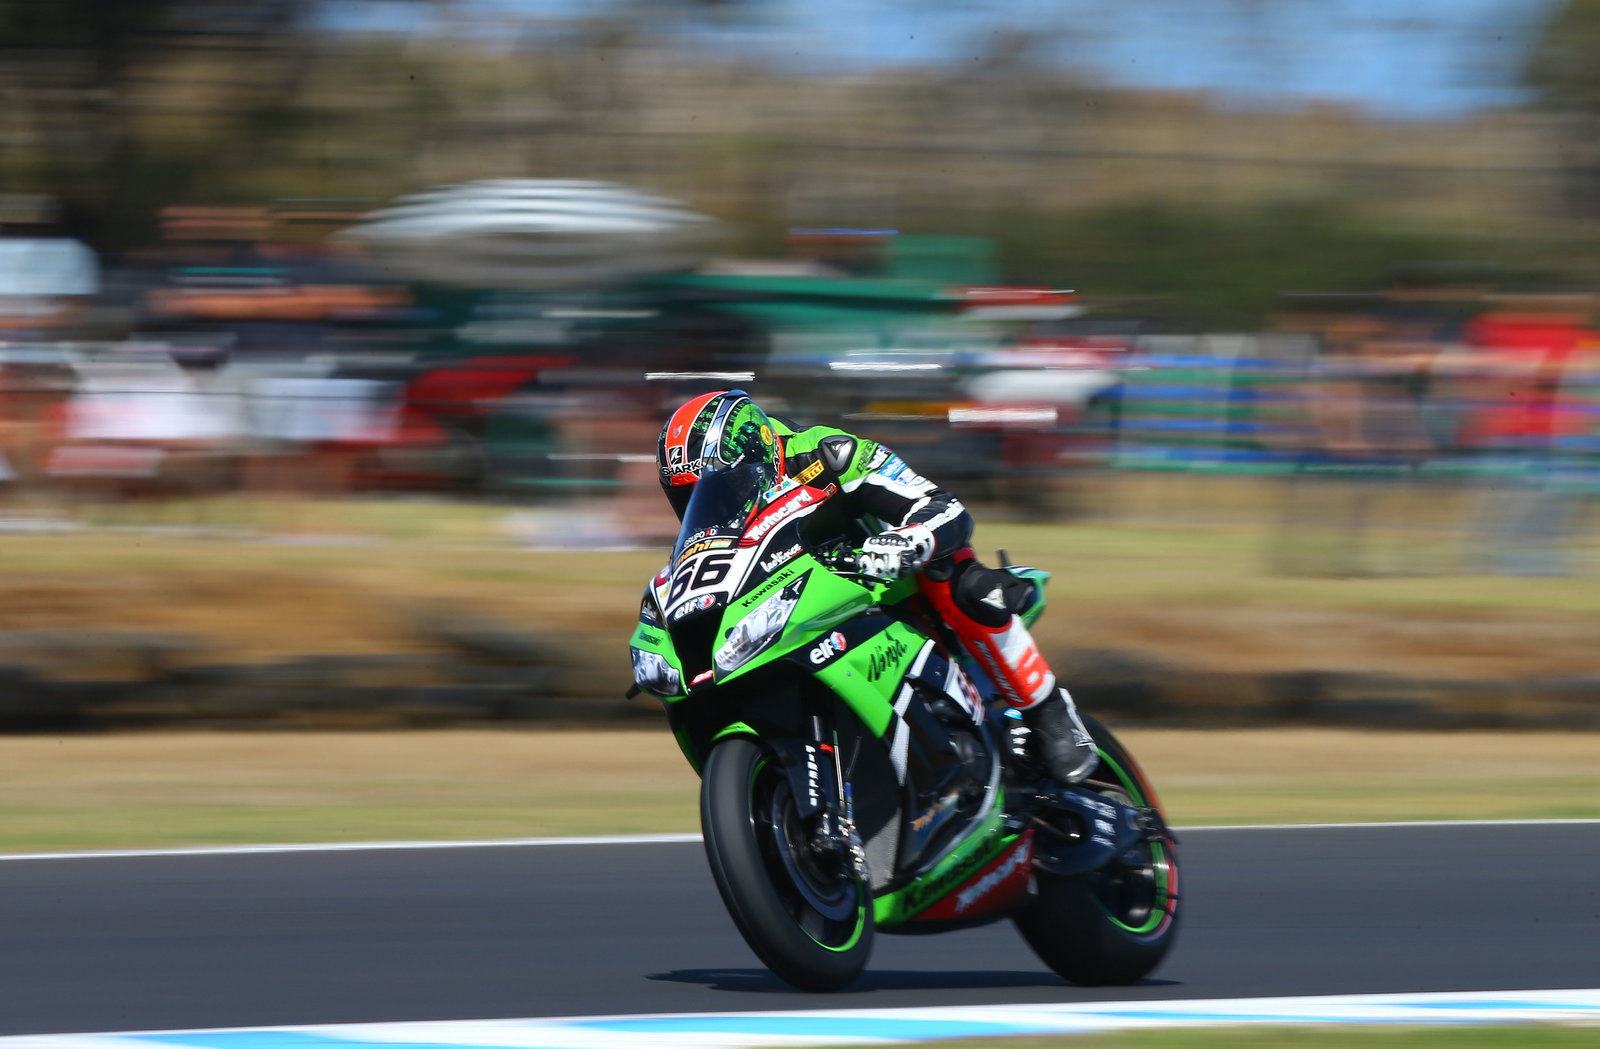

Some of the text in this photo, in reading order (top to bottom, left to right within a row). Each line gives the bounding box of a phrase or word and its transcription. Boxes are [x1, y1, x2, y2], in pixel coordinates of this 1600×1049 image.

[662, 458, 704, 476] SHARK
[743, 489, 814, 541] Motocard
[664, 553, 736, 612] 66
[741, 568, 795, 608] Kawasaki
[809, 639, 835, 664] elf
[867, 637, 908, 682] Ninja
